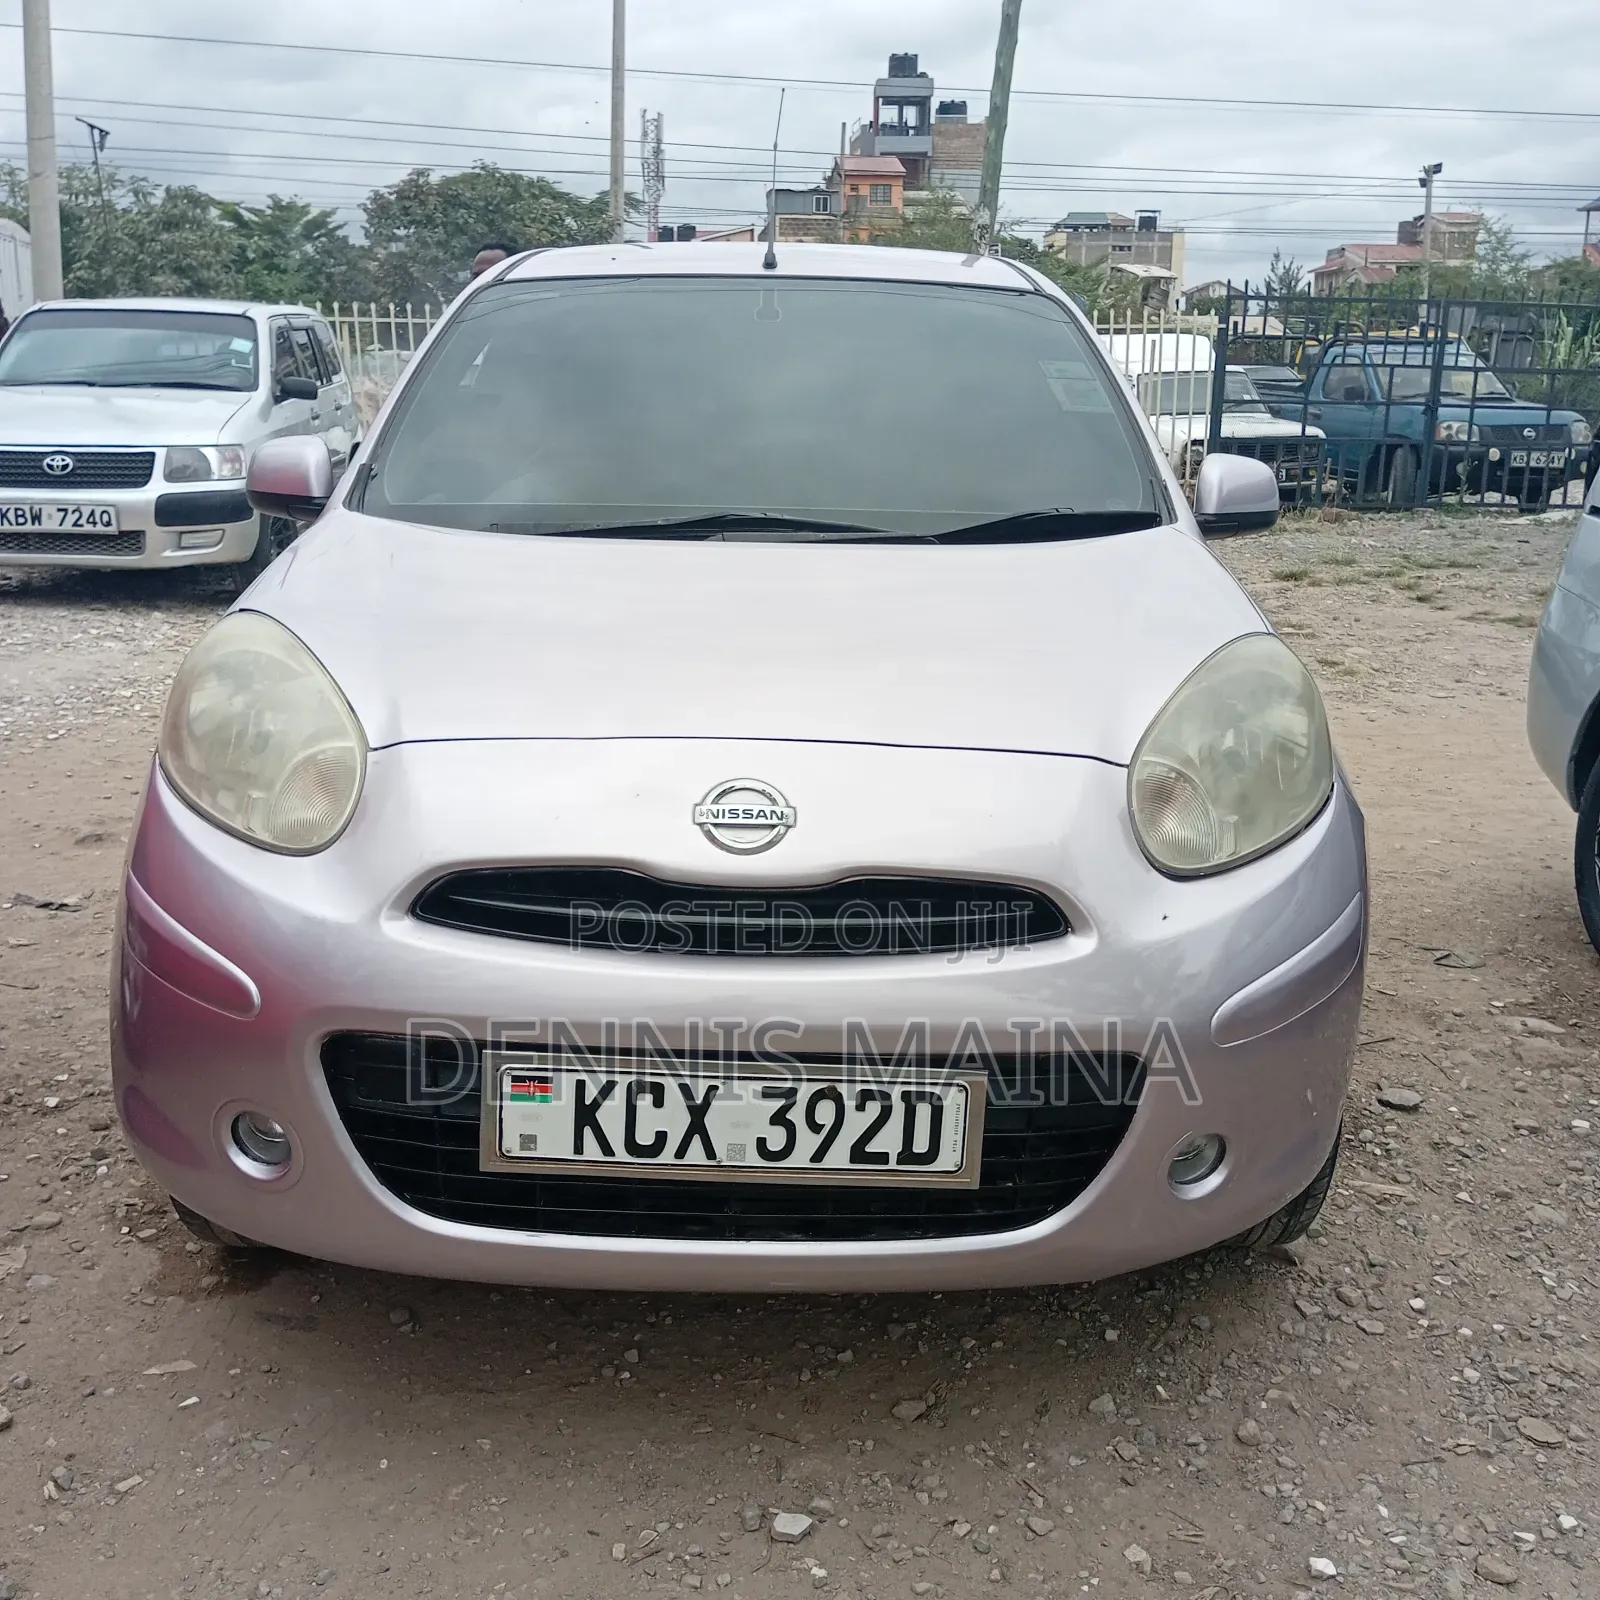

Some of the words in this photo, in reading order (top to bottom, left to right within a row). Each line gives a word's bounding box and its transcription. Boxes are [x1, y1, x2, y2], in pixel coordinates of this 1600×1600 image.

[0, 507, 42, 527] KBW
[56, 507, 113, 528] 724Q
[705, 808, 784, 821] NISSAN
[573, 1079, 719, 1161] KCX
[756, 1085, 943, 1166] 392D
